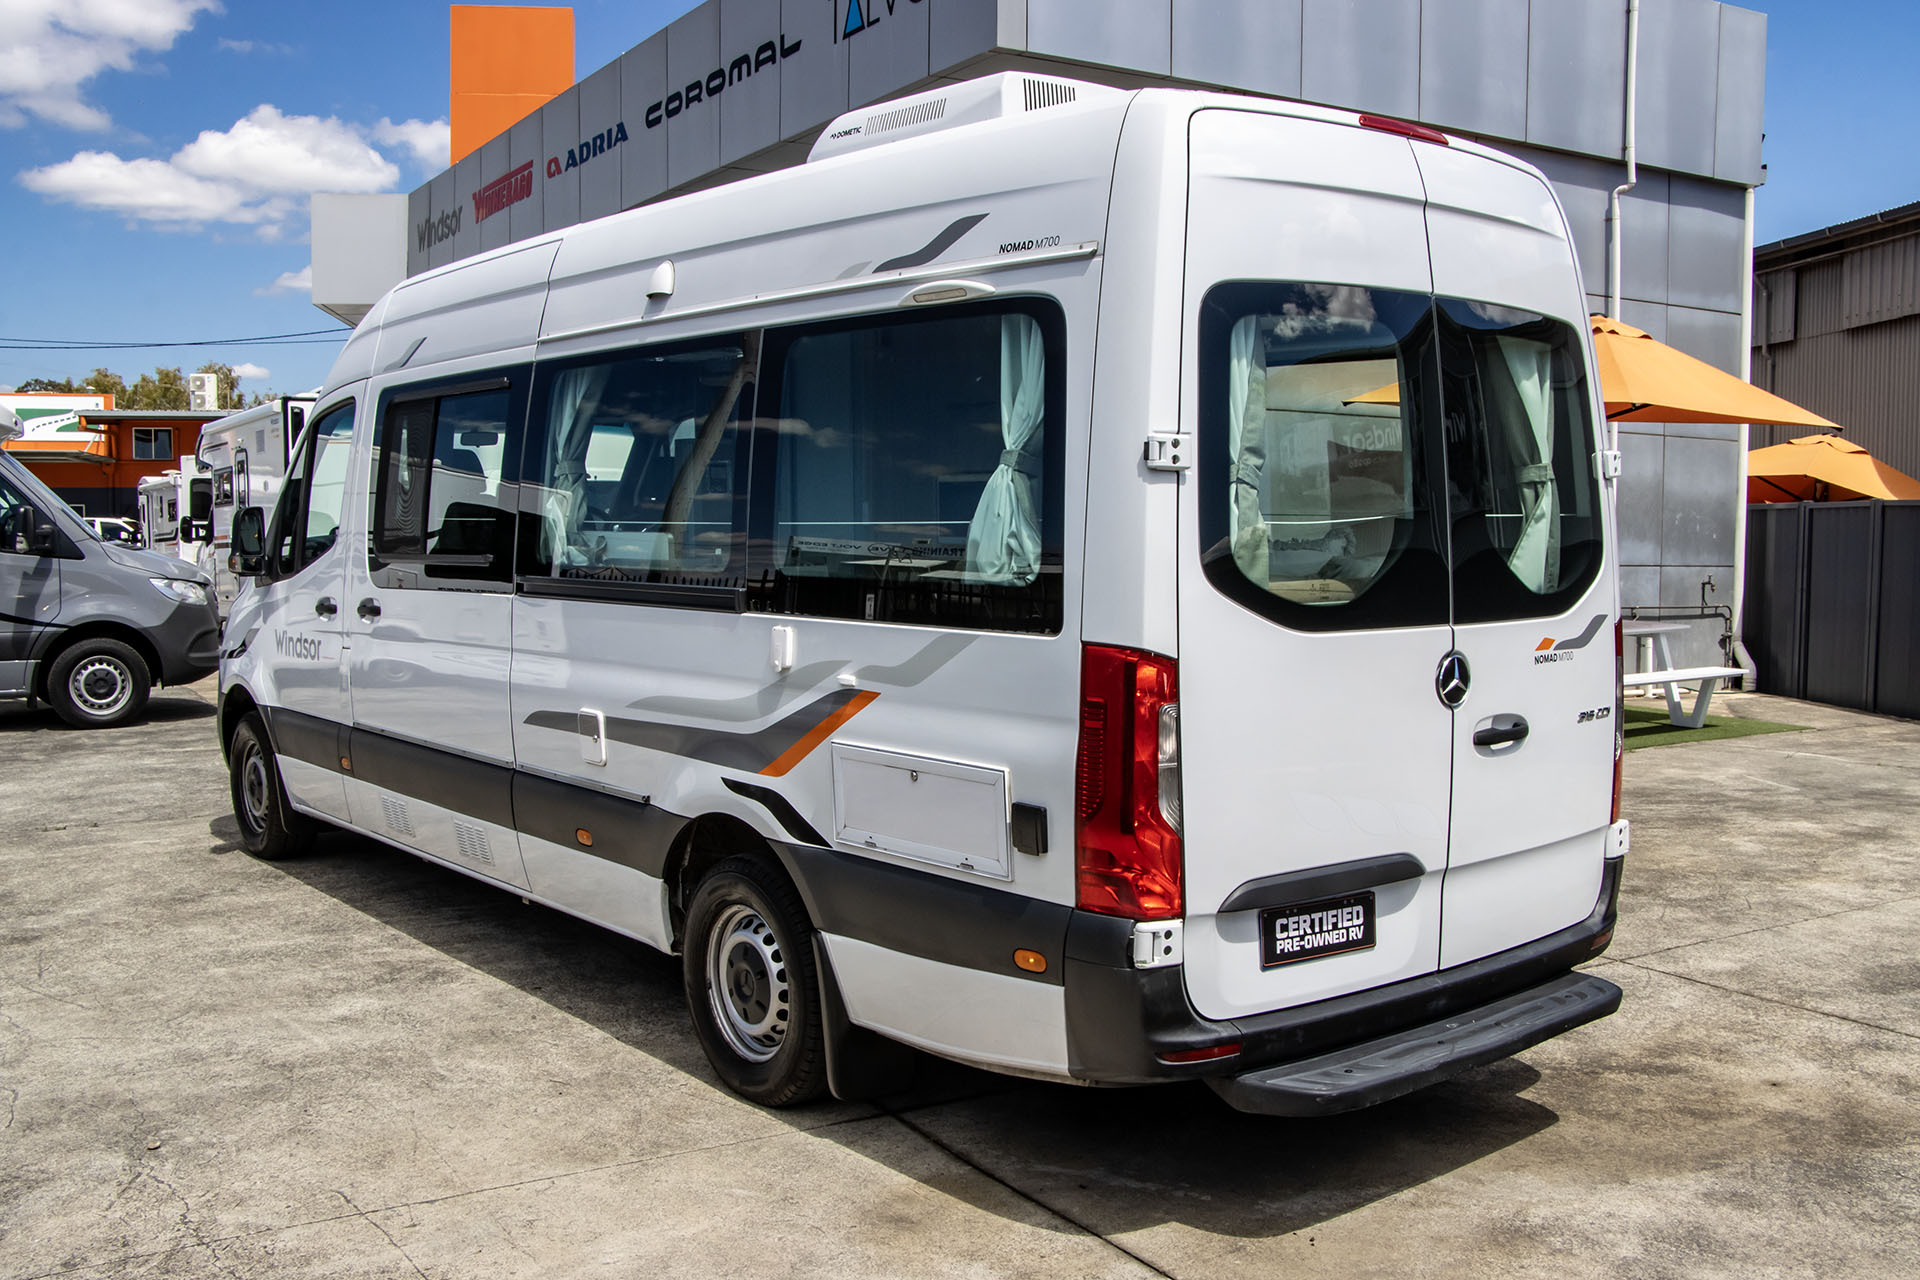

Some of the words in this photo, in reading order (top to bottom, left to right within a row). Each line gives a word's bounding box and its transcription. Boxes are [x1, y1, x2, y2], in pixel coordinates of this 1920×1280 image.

[645, 33, 802, 129] COROMAL
[564, 121, 629, 172] ADRIA
[836, 126, 862, 139] DOMETIC
[417, 205, 463, 253] Windsor
[998, 240, 1034, 254] NOMAD
[1034, 235, 1061, 249] M700
[274, 628, 322, 661] Windsor
[1534, 653, 1558, 665] NOMAD
[1275, 905, 1364, 940] CERTIFIED
[1276, 929, 1348, 954] PRE-OWNED
[1348, 925, 1364, 941] RV
